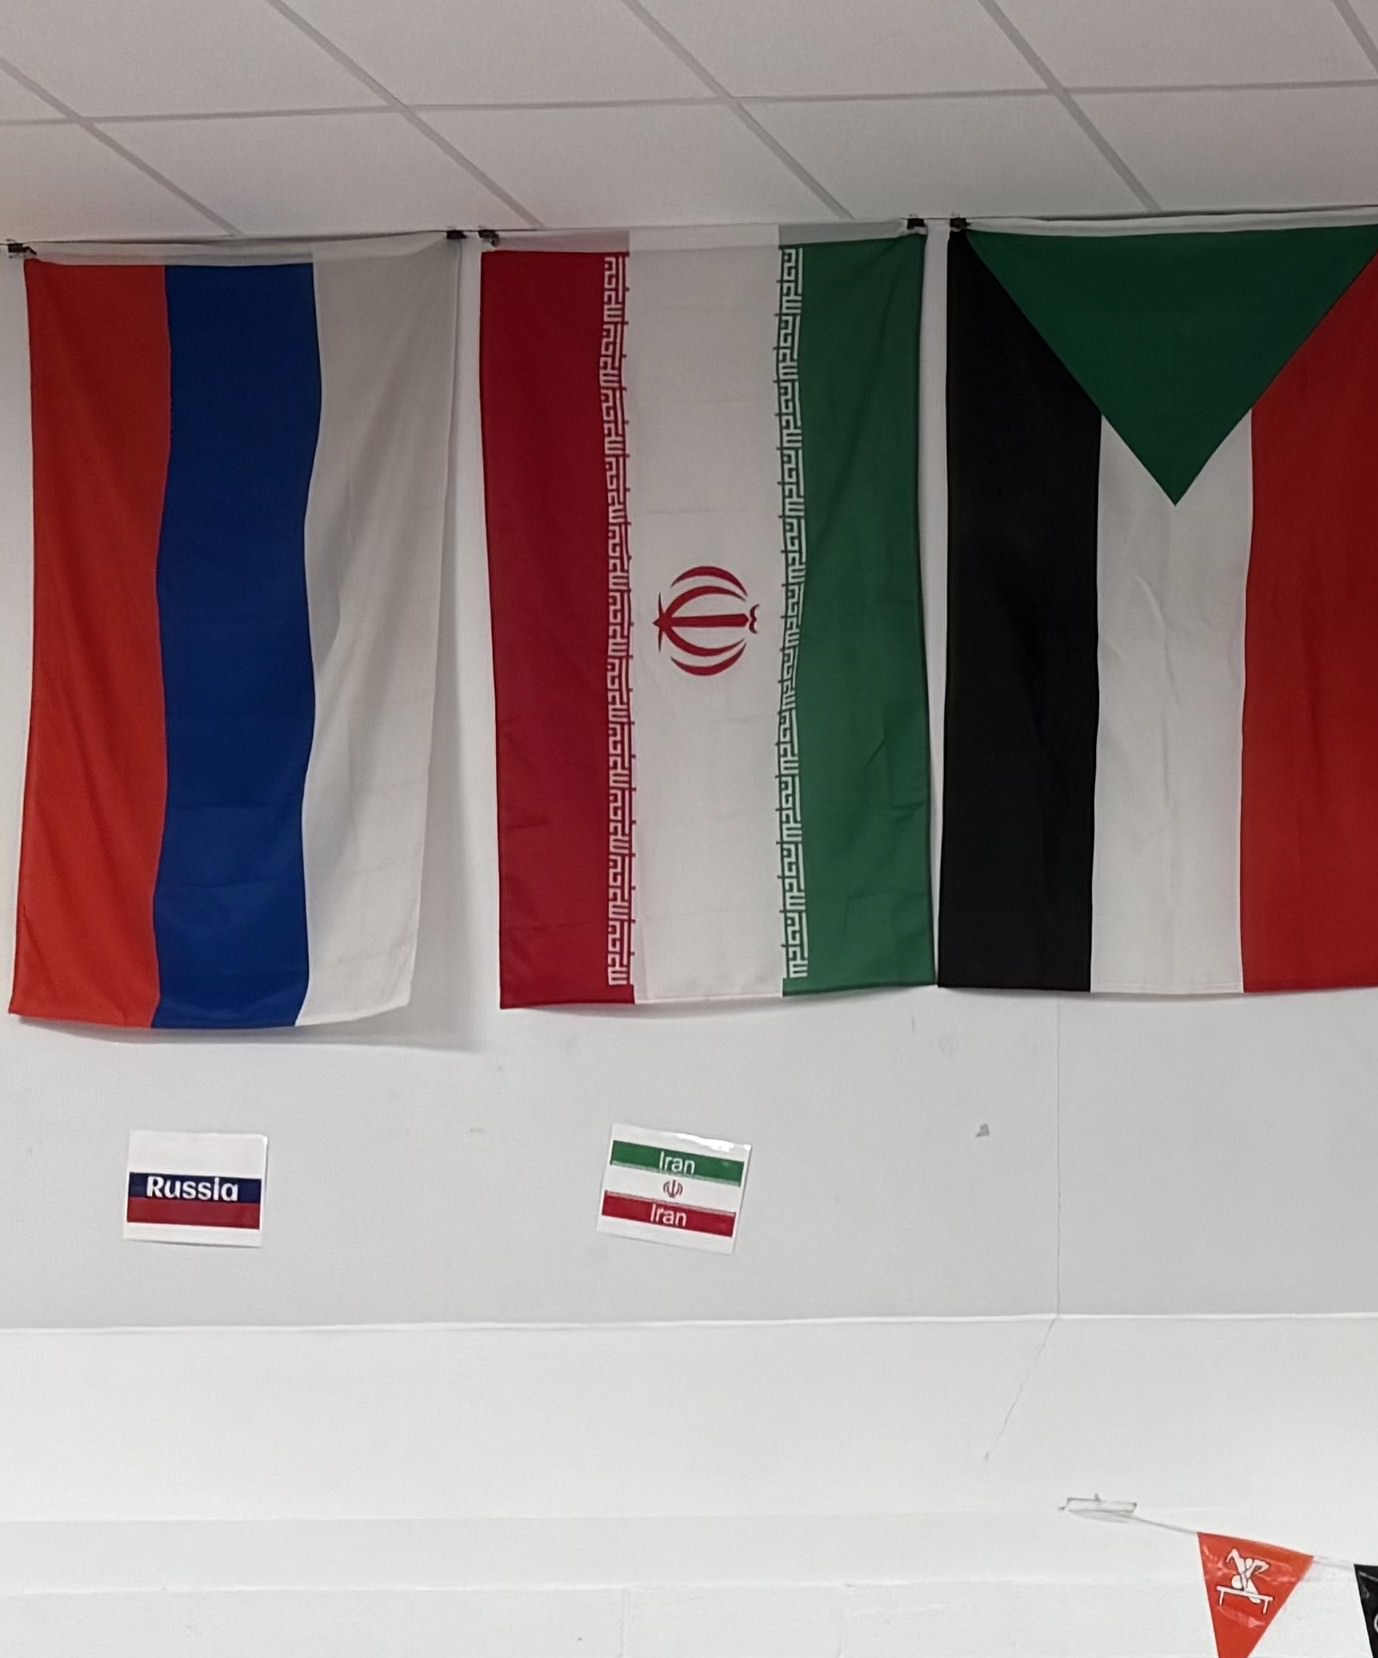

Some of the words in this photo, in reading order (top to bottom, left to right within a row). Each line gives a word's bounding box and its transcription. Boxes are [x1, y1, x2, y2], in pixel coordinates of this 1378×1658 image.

[659, 1151, 696, 1175] Iran
[146, 1176, 239, 1201] Russia
[650, 1204, 687, 1228] Iran
